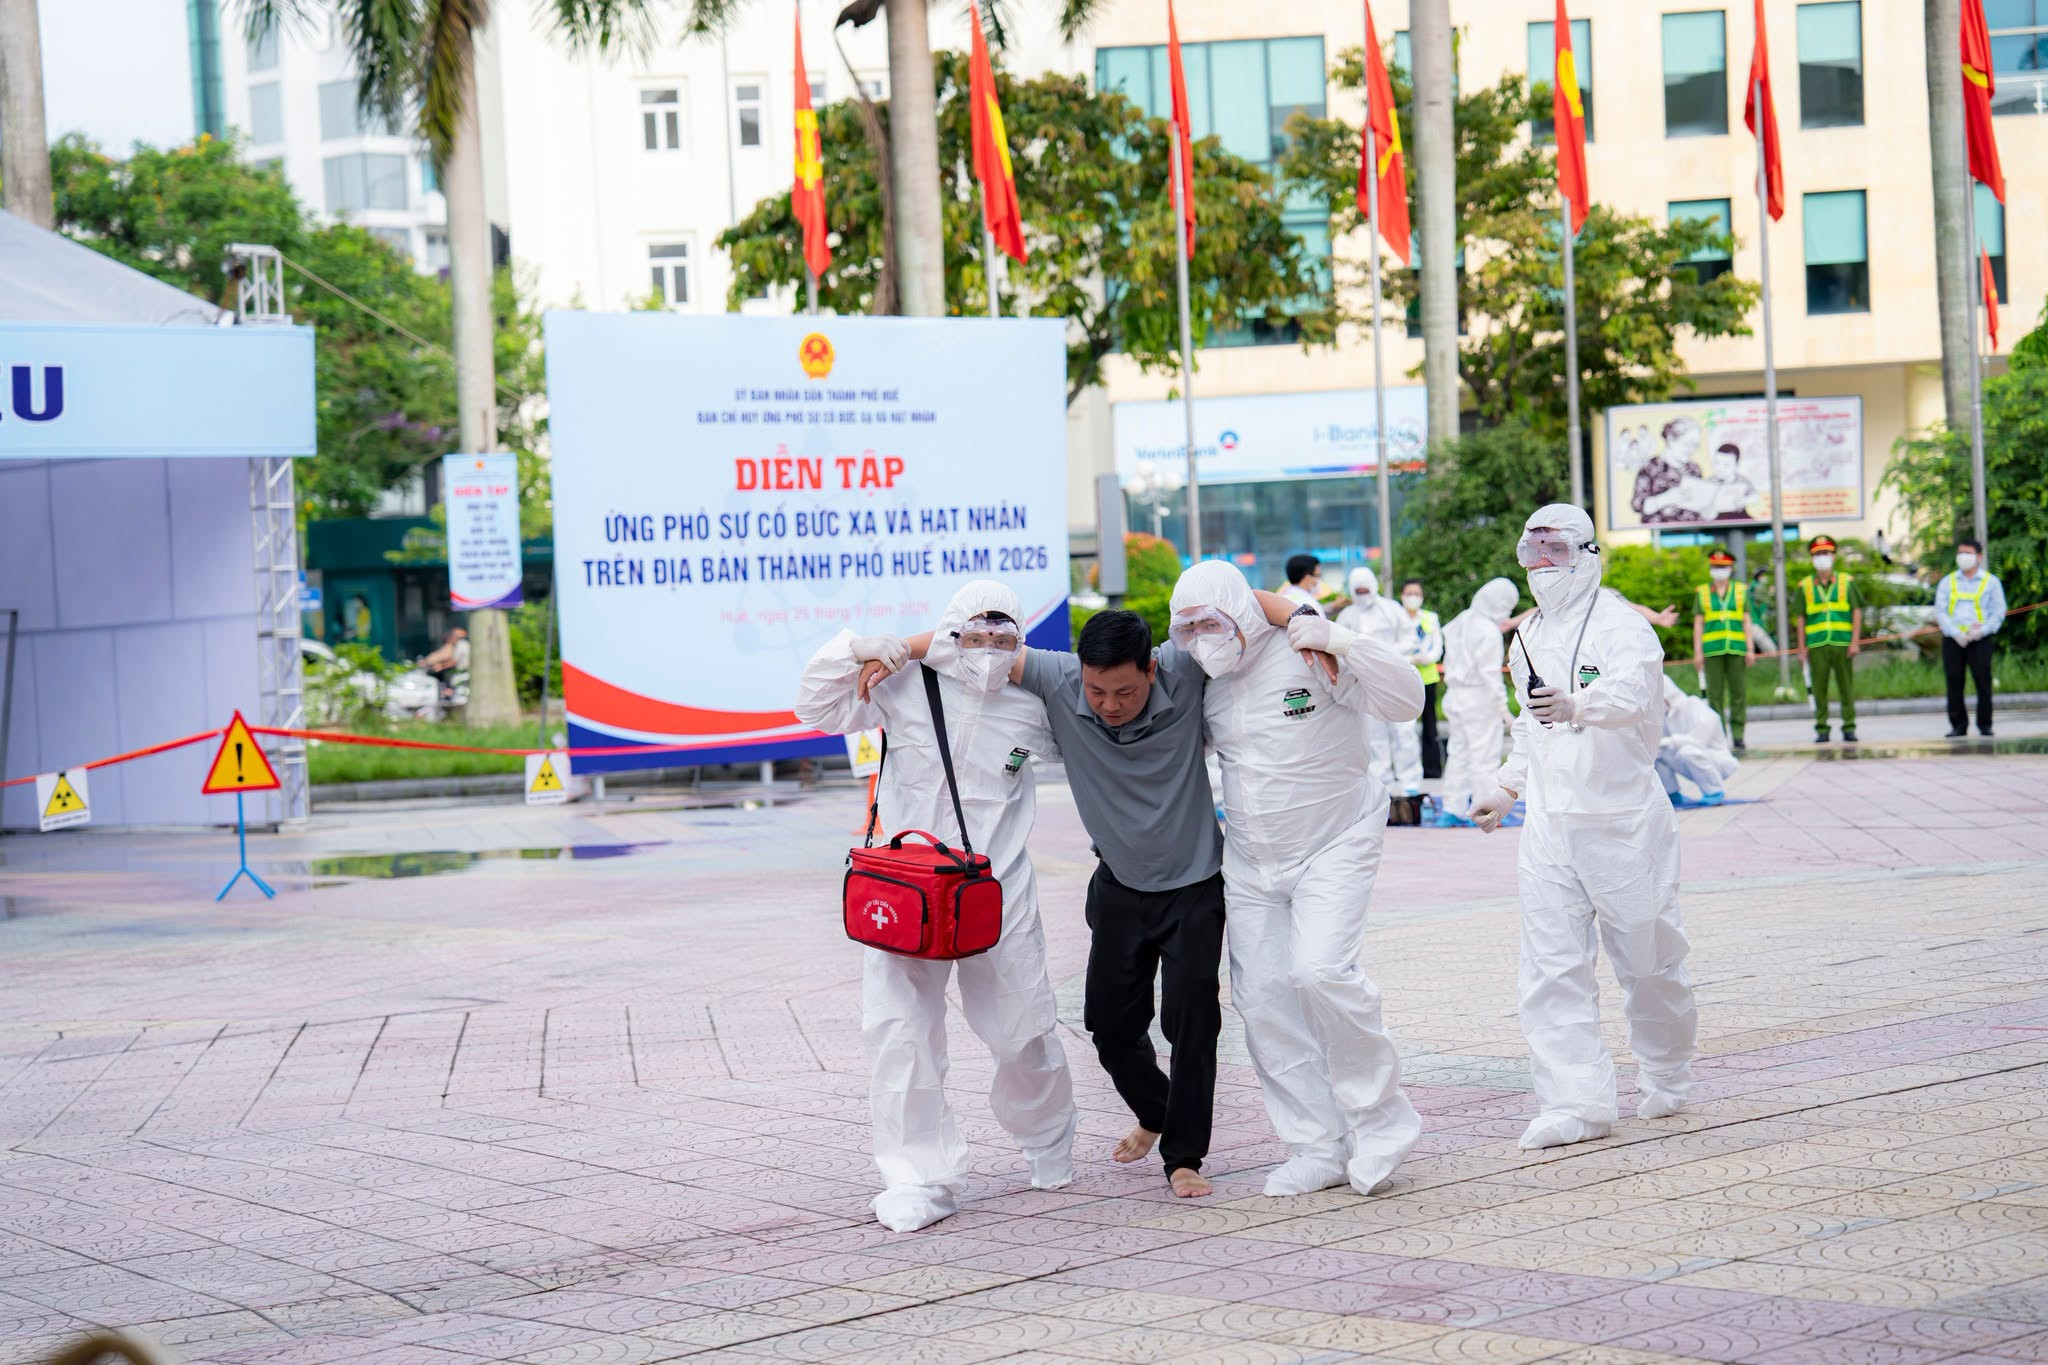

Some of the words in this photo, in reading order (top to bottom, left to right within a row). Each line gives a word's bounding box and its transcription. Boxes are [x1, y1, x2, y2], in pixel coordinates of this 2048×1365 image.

[0, 363, 63, 422] U
[735, 443, 823, 491] DIỄN
[835, 449, 905, 497] TẬP
[605, 508, 654, 543] ỨNG
[663, 506, 710, 541] PHÓ
[719, 510, 751, 546] SỰ
[758, 500, 786, 538] CỐ
[796, 504, 839, 537] BỨC
[849, 509, 877, 542] XẠ
[885, 502, 912, 534] VÀ
[921, 506, 959, 539] HẠT
[968, 499, 1027, 531] NHÂN
[583, 552, 645, 587] TRÊN
[654, 557, 692, 592] ĐỊA
[701, 548, 748, 583] BÀN
[757, 548, 831, 581] THÀNH
[840, 541, 884, 579] PHỐ
[892, 541, 934, 576] HUẾ
[942, 543, 991, 575] NĂM
[999, 546, 1048, 572] 2026
